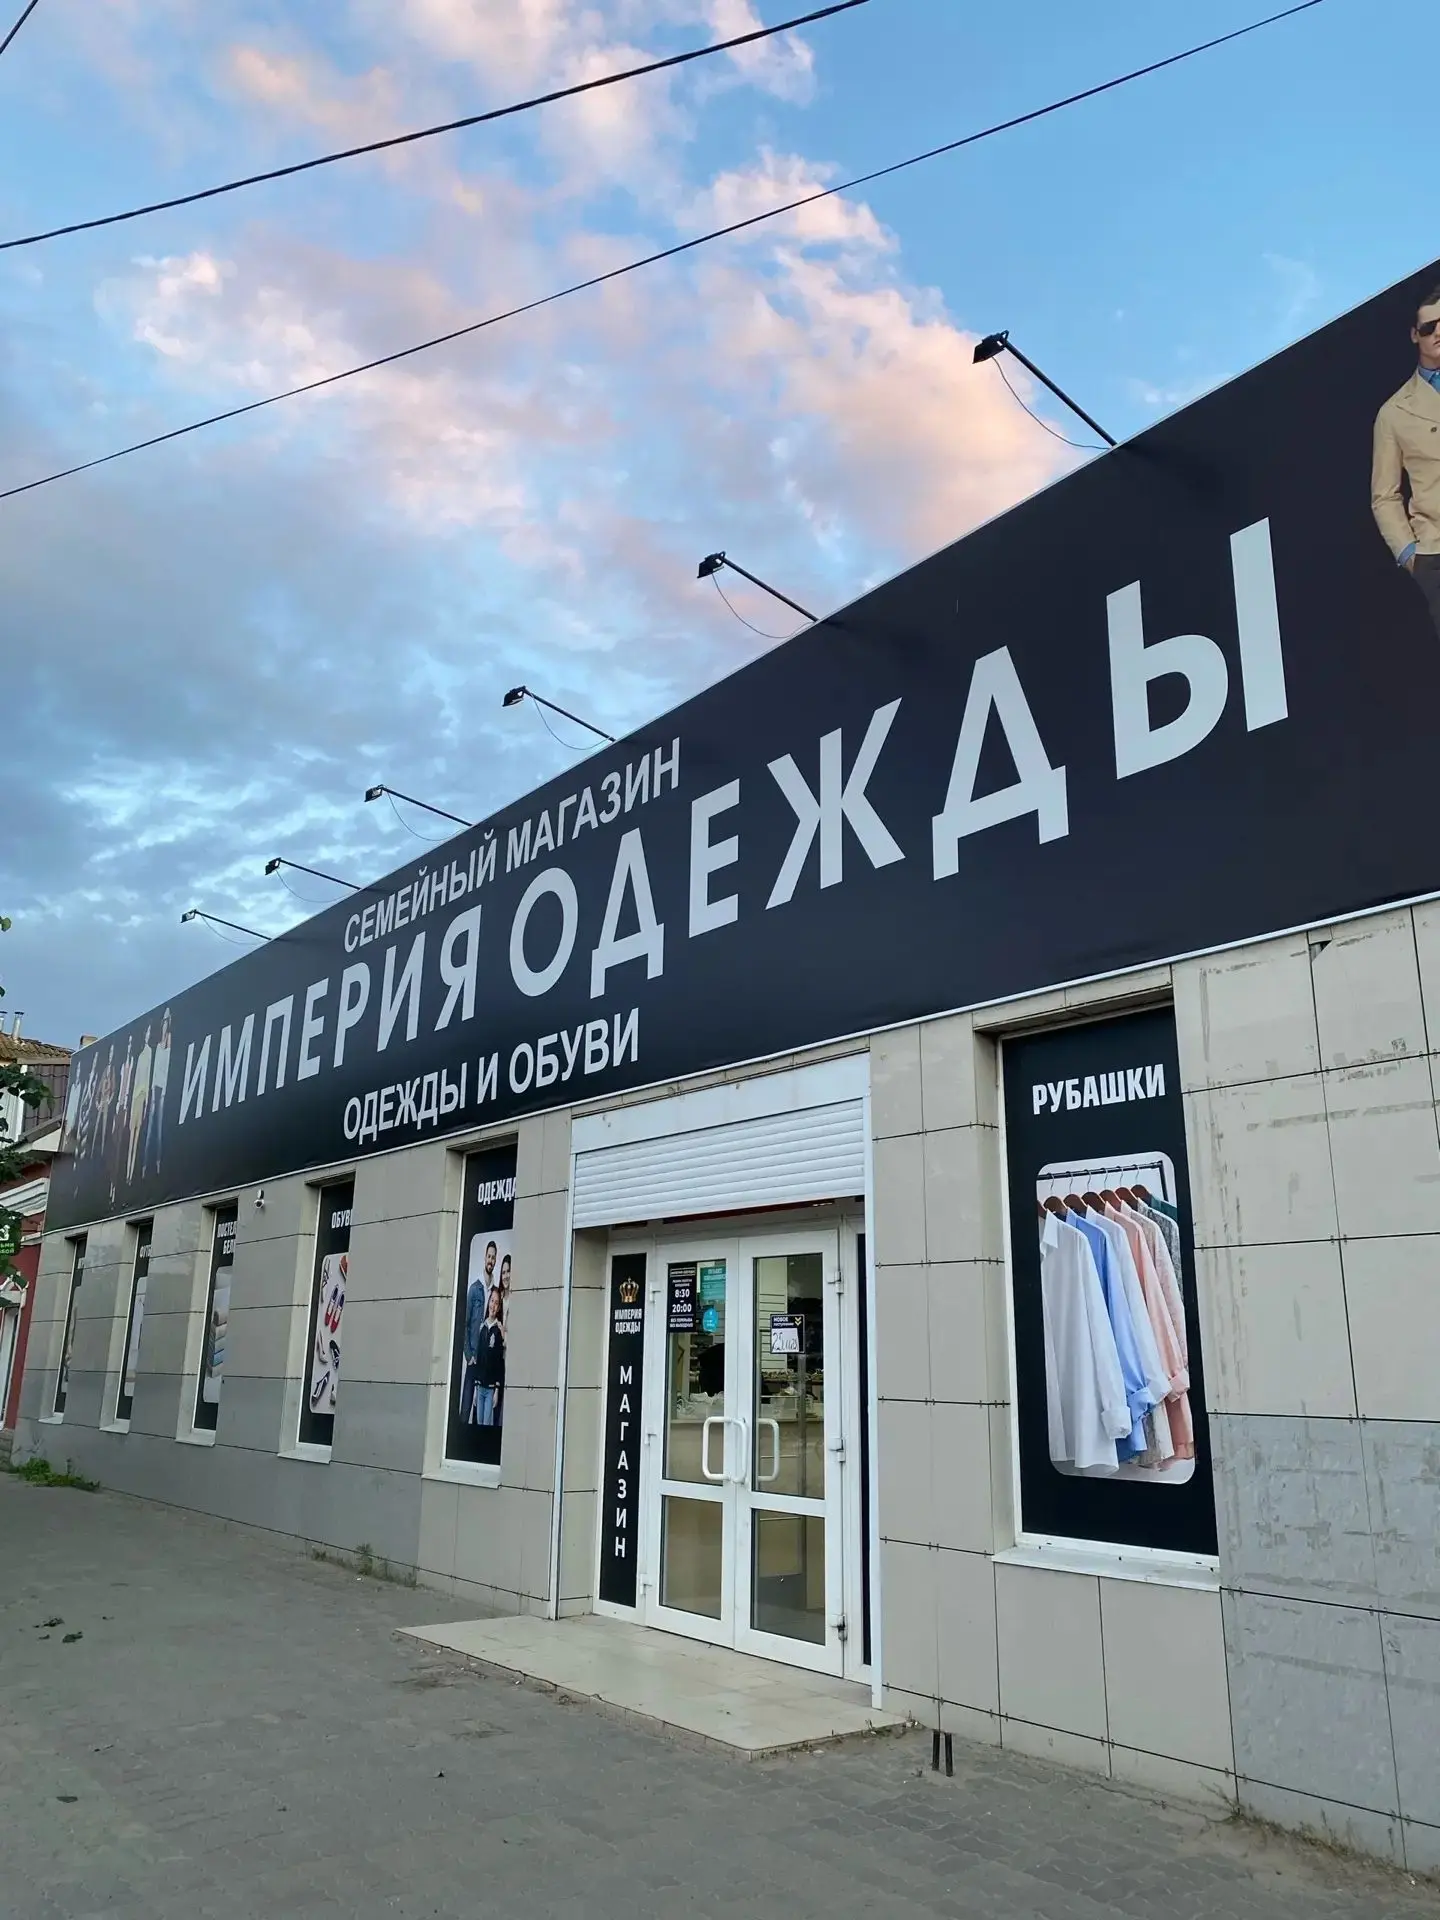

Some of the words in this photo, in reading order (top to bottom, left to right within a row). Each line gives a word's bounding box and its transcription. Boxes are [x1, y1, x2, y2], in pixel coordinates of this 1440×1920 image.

[178, 904, 482, 1125] ИМПЕРИЯ
[509, 517, 1288, 999] ОДЕЖДЫ
[344, 829, 497, 953] СЕМЕЙНЫЙ
[505, 736, 680, 874] МАГАЗИН
[343, 1062, 467, 1145] ОДЕЖДЫ
[477, 1052, 498, 1105] И
[508, 1007, 639, 1095] ОБУВИ
[1032, 1063, 1166, 1115] РУБАШКИ
[614, 1308, 642, 1320] ИМПЕРИЯ
[672, 1303, 692, 1313] 20:00
[674, 1288, 690, 1298] 8:30
[615, 1321, 641, 1334] ОДЕЖДЫ
[614, 1365, 633, 1558] МАГАЗИН
